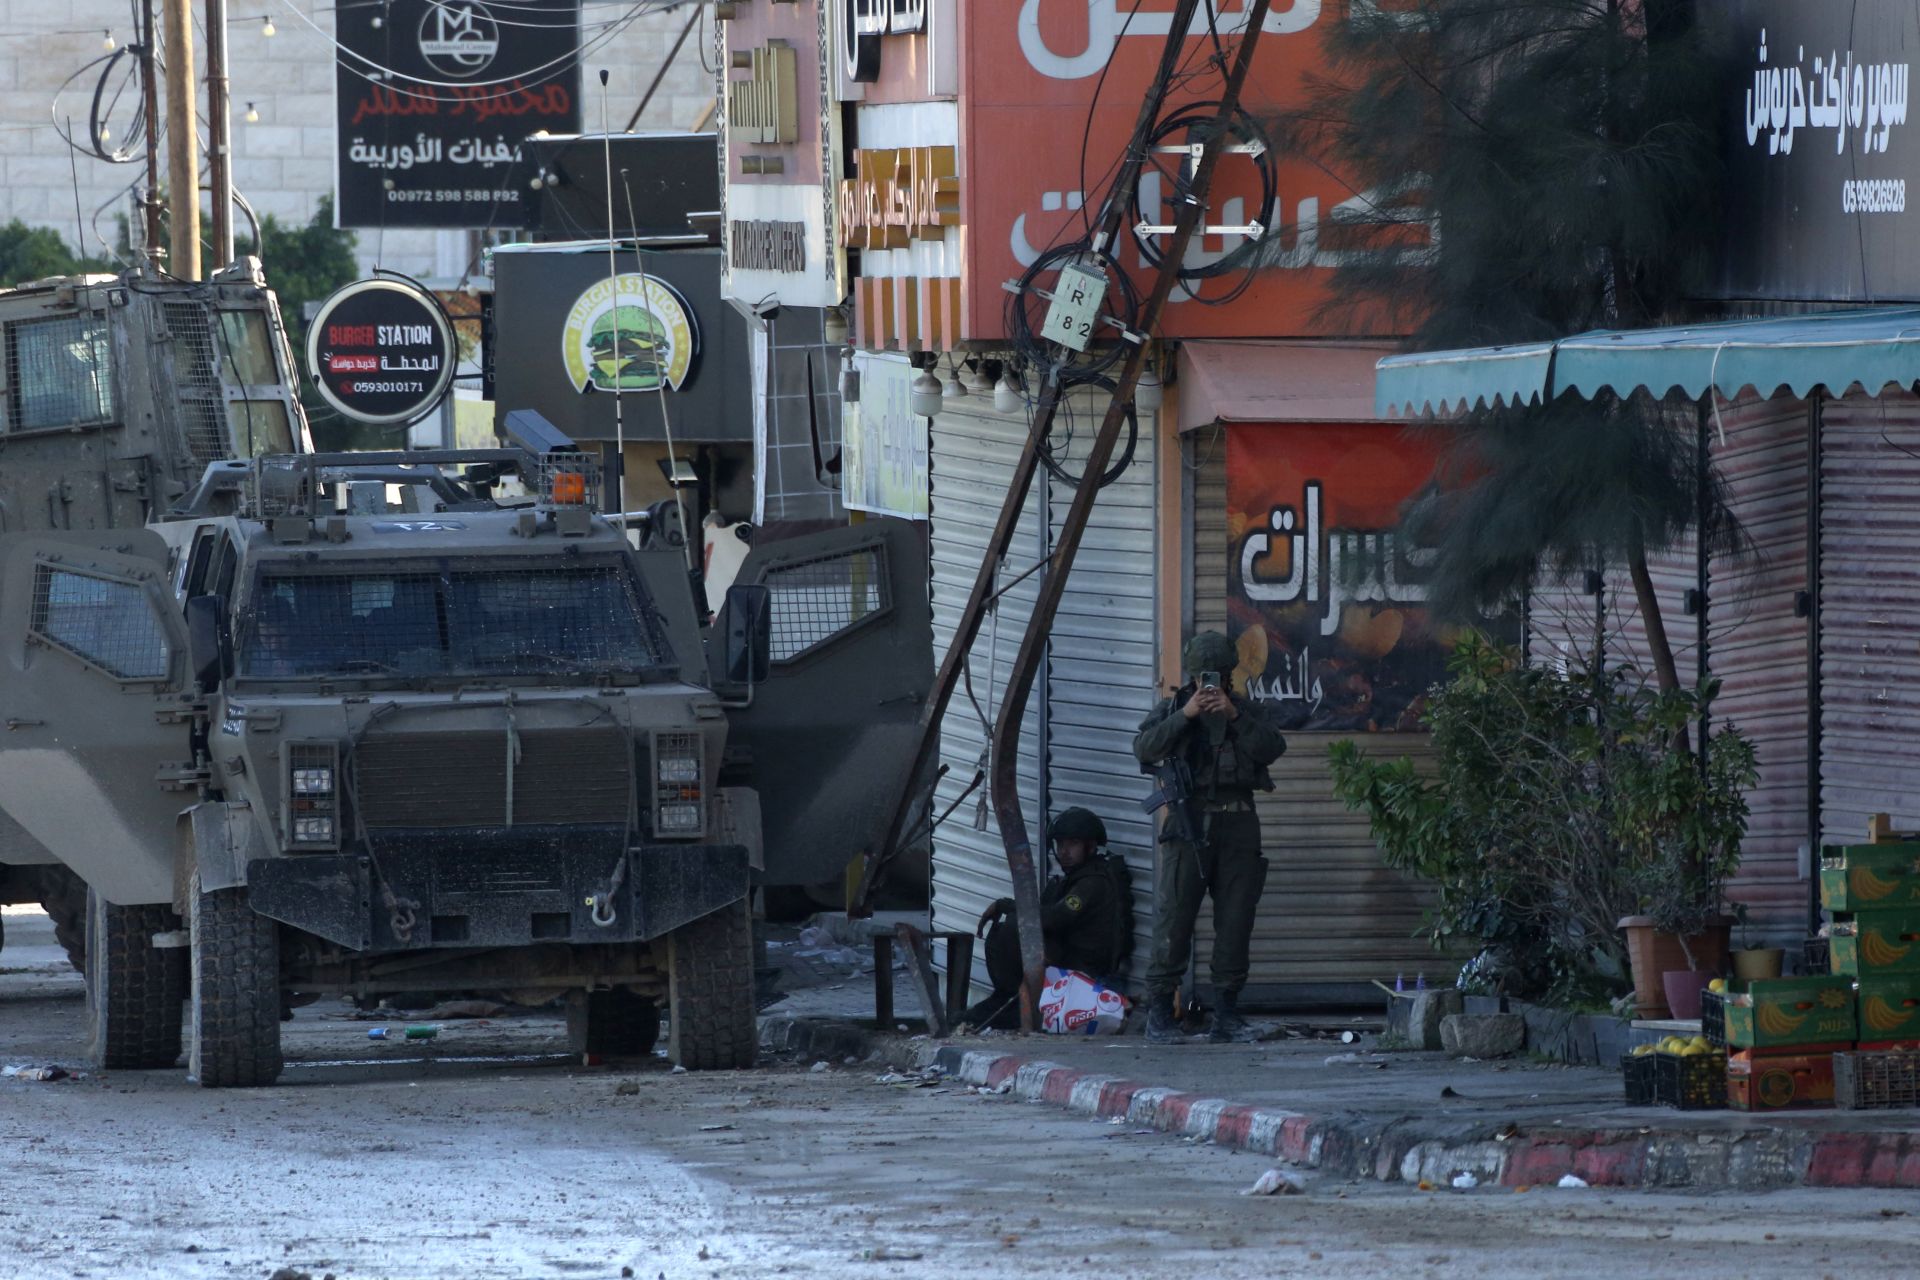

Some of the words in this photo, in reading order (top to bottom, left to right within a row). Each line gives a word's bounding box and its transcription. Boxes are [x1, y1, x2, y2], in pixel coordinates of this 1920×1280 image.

[449, 79, 571, 123] محمود
[1808, 50, 1864, 155] ماركت
[1864, 62, 1909, 154] سوبر
[349, 132, 442, 169] الأوربية
[388, 190, 433, 202] 00972
[435, 190, 462, 202] 598
[1842, 178, 1906, 214] 0599826928
[625, 278, 683, 327] STATION
[1070, 289, 1085, 306] R
[329, 324, 376, 347] BURGER
[378, 324, 433, 346] STATION
[380, 355, 439, 372] المحطة
[353, 381, 424, 393] 0593010171
